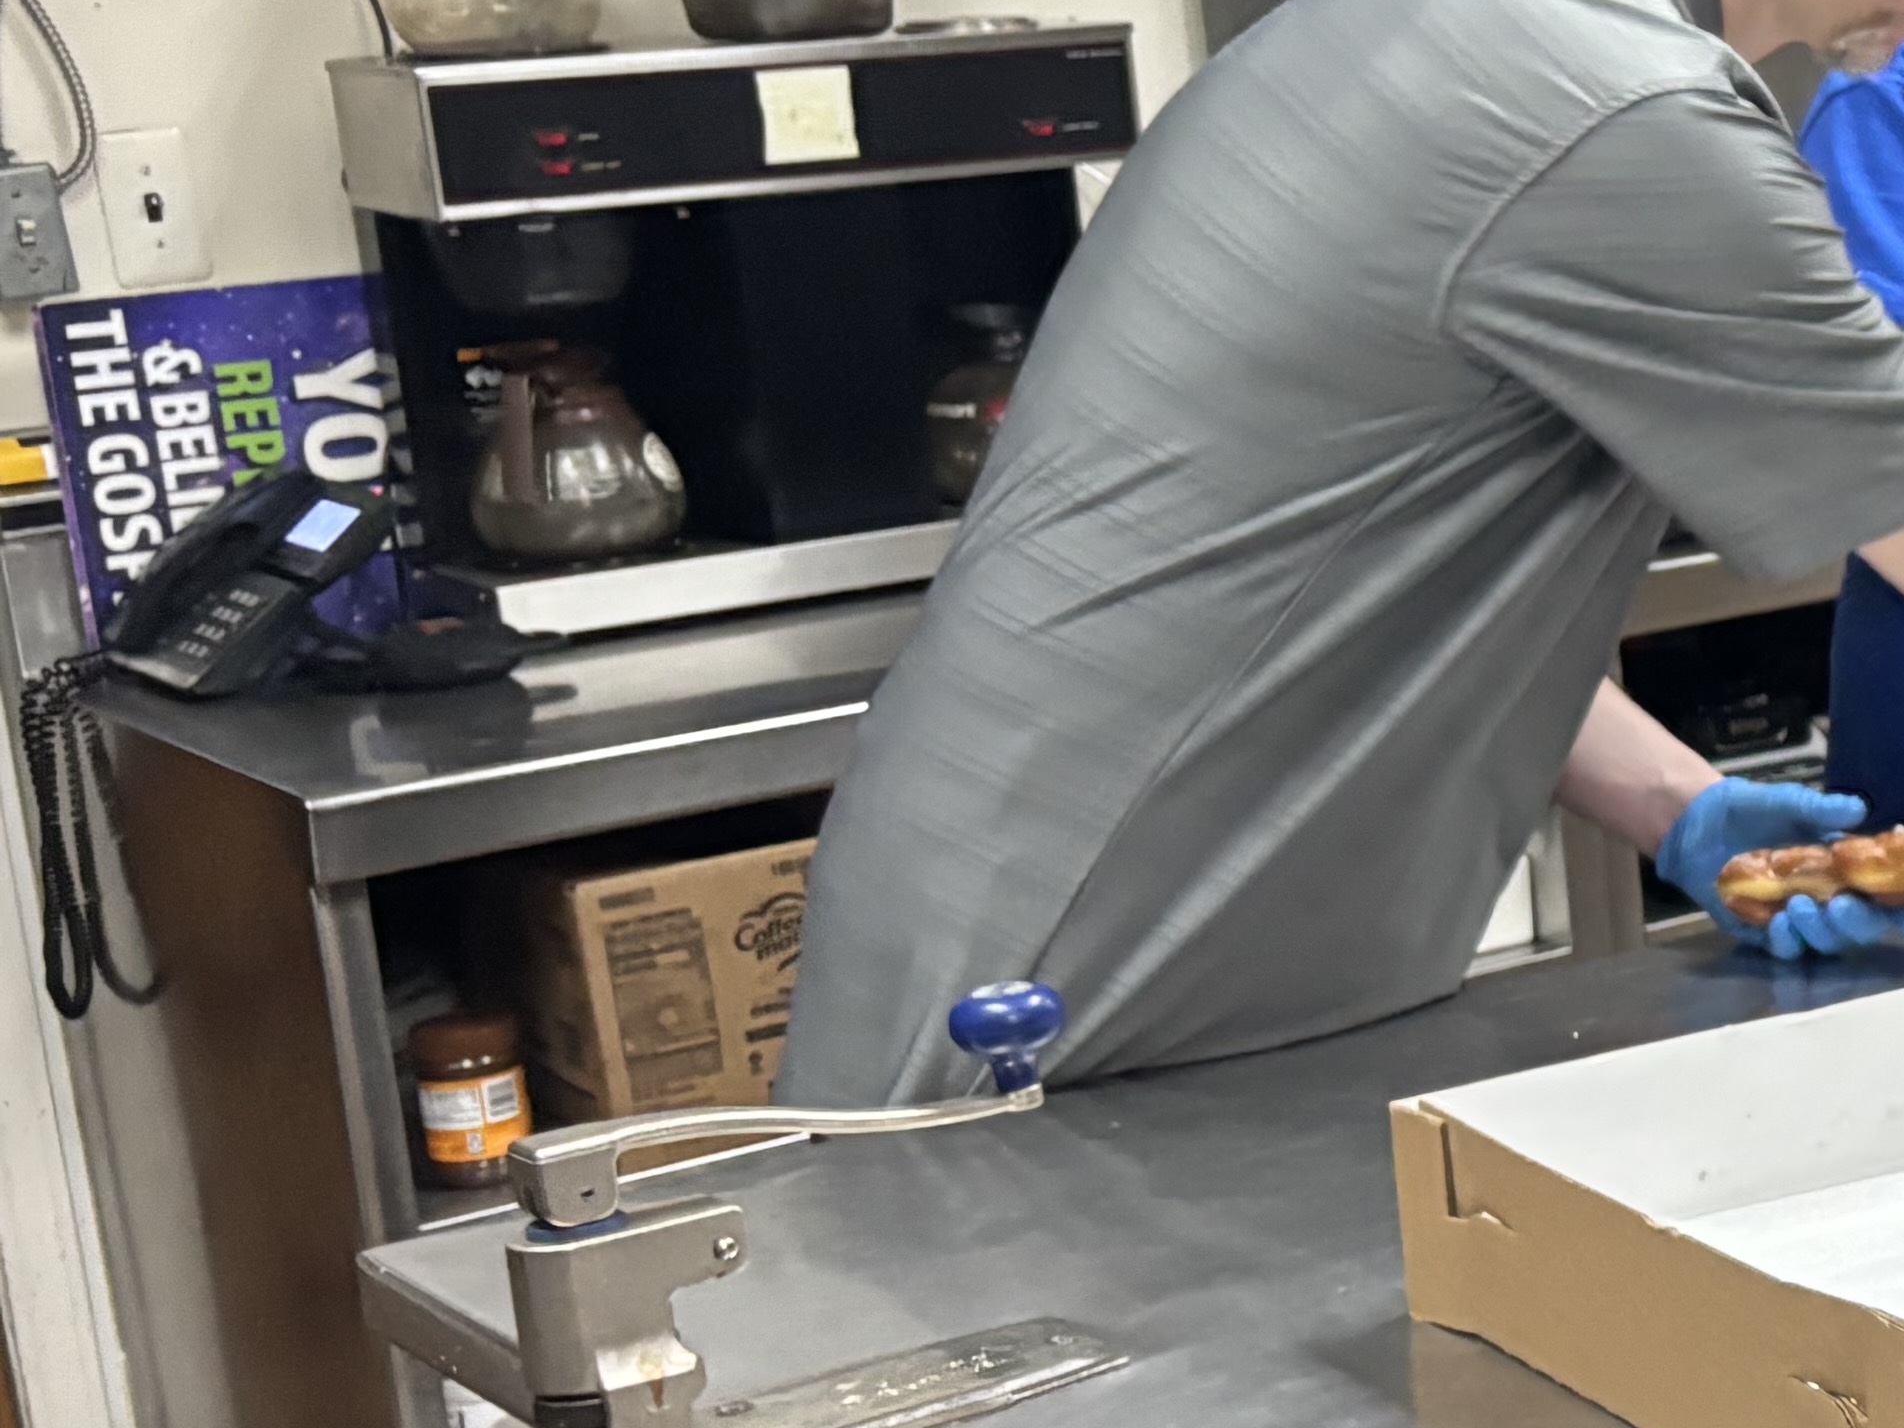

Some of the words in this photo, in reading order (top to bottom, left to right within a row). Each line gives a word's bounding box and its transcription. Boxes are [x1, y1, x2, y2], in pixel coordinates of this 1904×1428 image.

[65, 308, 141, 427] THE
[142, 338, 203, 387] &
[213, 359, 286, 487] REP
[293, 348, 389, 483] YO
[150, 390, 226, 534] BELI
